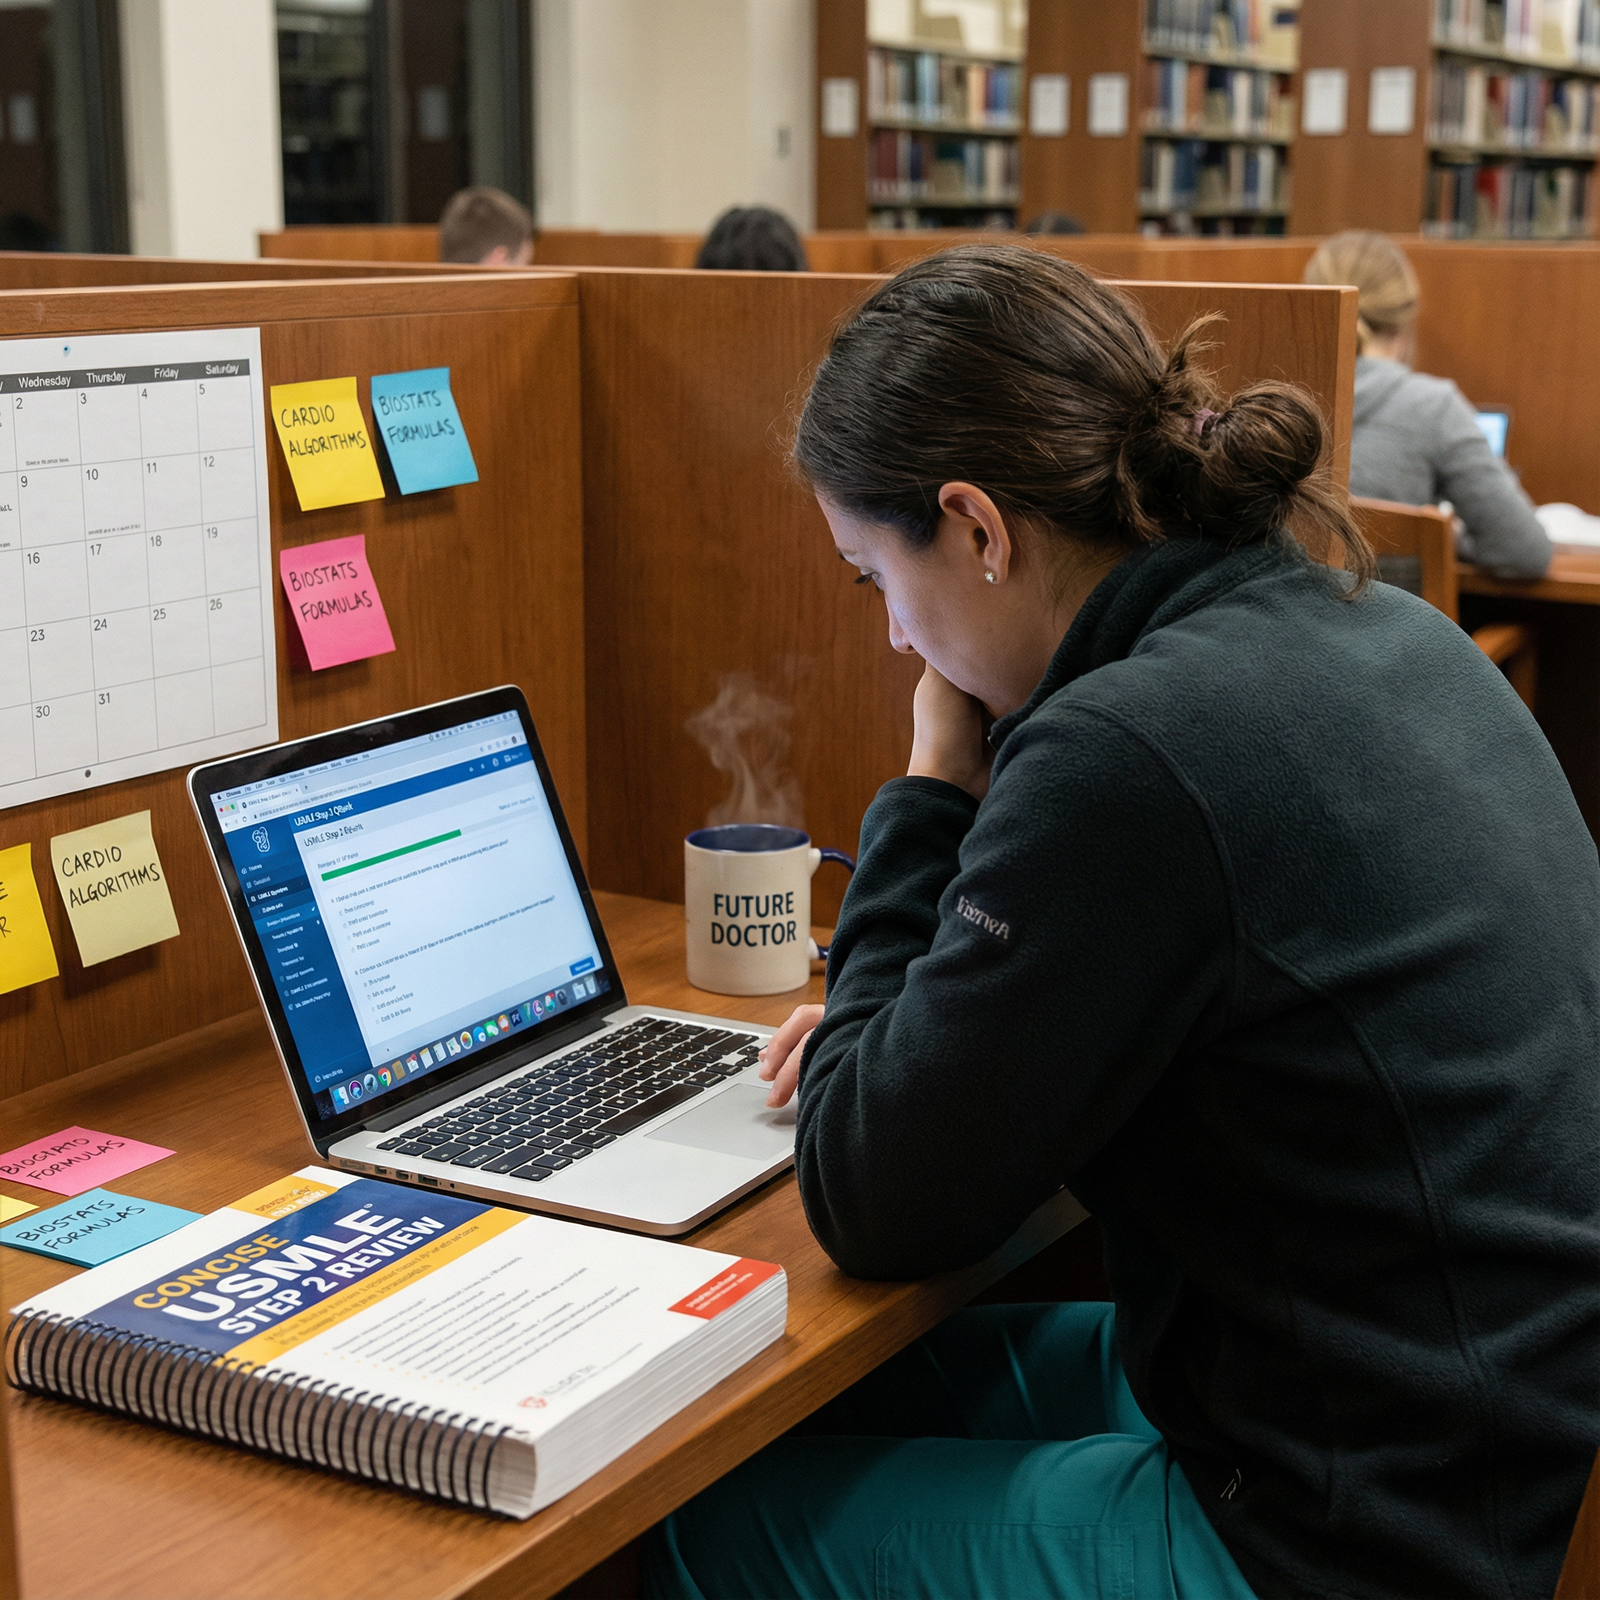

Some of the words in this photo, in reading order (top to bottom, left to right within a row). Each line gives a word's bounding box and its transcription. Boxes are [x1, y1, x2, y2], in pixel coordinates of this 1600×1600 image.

[86, 371, 126, 384] Thursday
[154, 368, 179, 379] Friday
[15, 397, 23, 409] 2
[80, 392, 87, 404] 3
[141, 388, 148, 399] 4
[199, 384, 205, 395] 5
[378, 389, 441, 416] BIOSTATS
[281, 404, 335, 428] CARDIO
[289, 430, 367, 458] ALGORITHMS
[387, 418, 455, 446] FORMULAS
[21, 476, 28, 487] 9
[86, 468, 98, 480] 10
[146, 462, 157, 474] 11
[203, 456, 215, 468] 12
[27, 553, 40, 565] 16
[90, 544, 102, 556] 17
[150, 535, 162, 547] 18
[206, 527, 218, 539] 19
[289, 561, 358, 592] BIOSTATS
[31, 629, 45, 642] 23
[93, 619, 108, 631] 24
[153, 608, 166, 621] 25
[210, 598, 222, 611] 26
[300, 590, 372, 623] FORMULAS
[36, 705, 50, 718] 30
[98, 692, 111, 705] 31
[62, 846, 122, 877] CARDIO
[69, 863, 161, 909] ALGORITHMS
[714, 891, 794, 918] FUTURE
[711, 920, 797, 947] DOCTOR
[26, 1140, 126, 1181] FORMULAS
[15, 1199, 115, 1242] BIOSTATS
[43, 1206, 146, 1250] FORMULAS
[133, 1233, 290, 1309] CONCISE
[218, 1289, 303, 1335] STEP
[301, 1276, 339, 1293] 2
[324, 1216, 446, 1279] REVIEW
